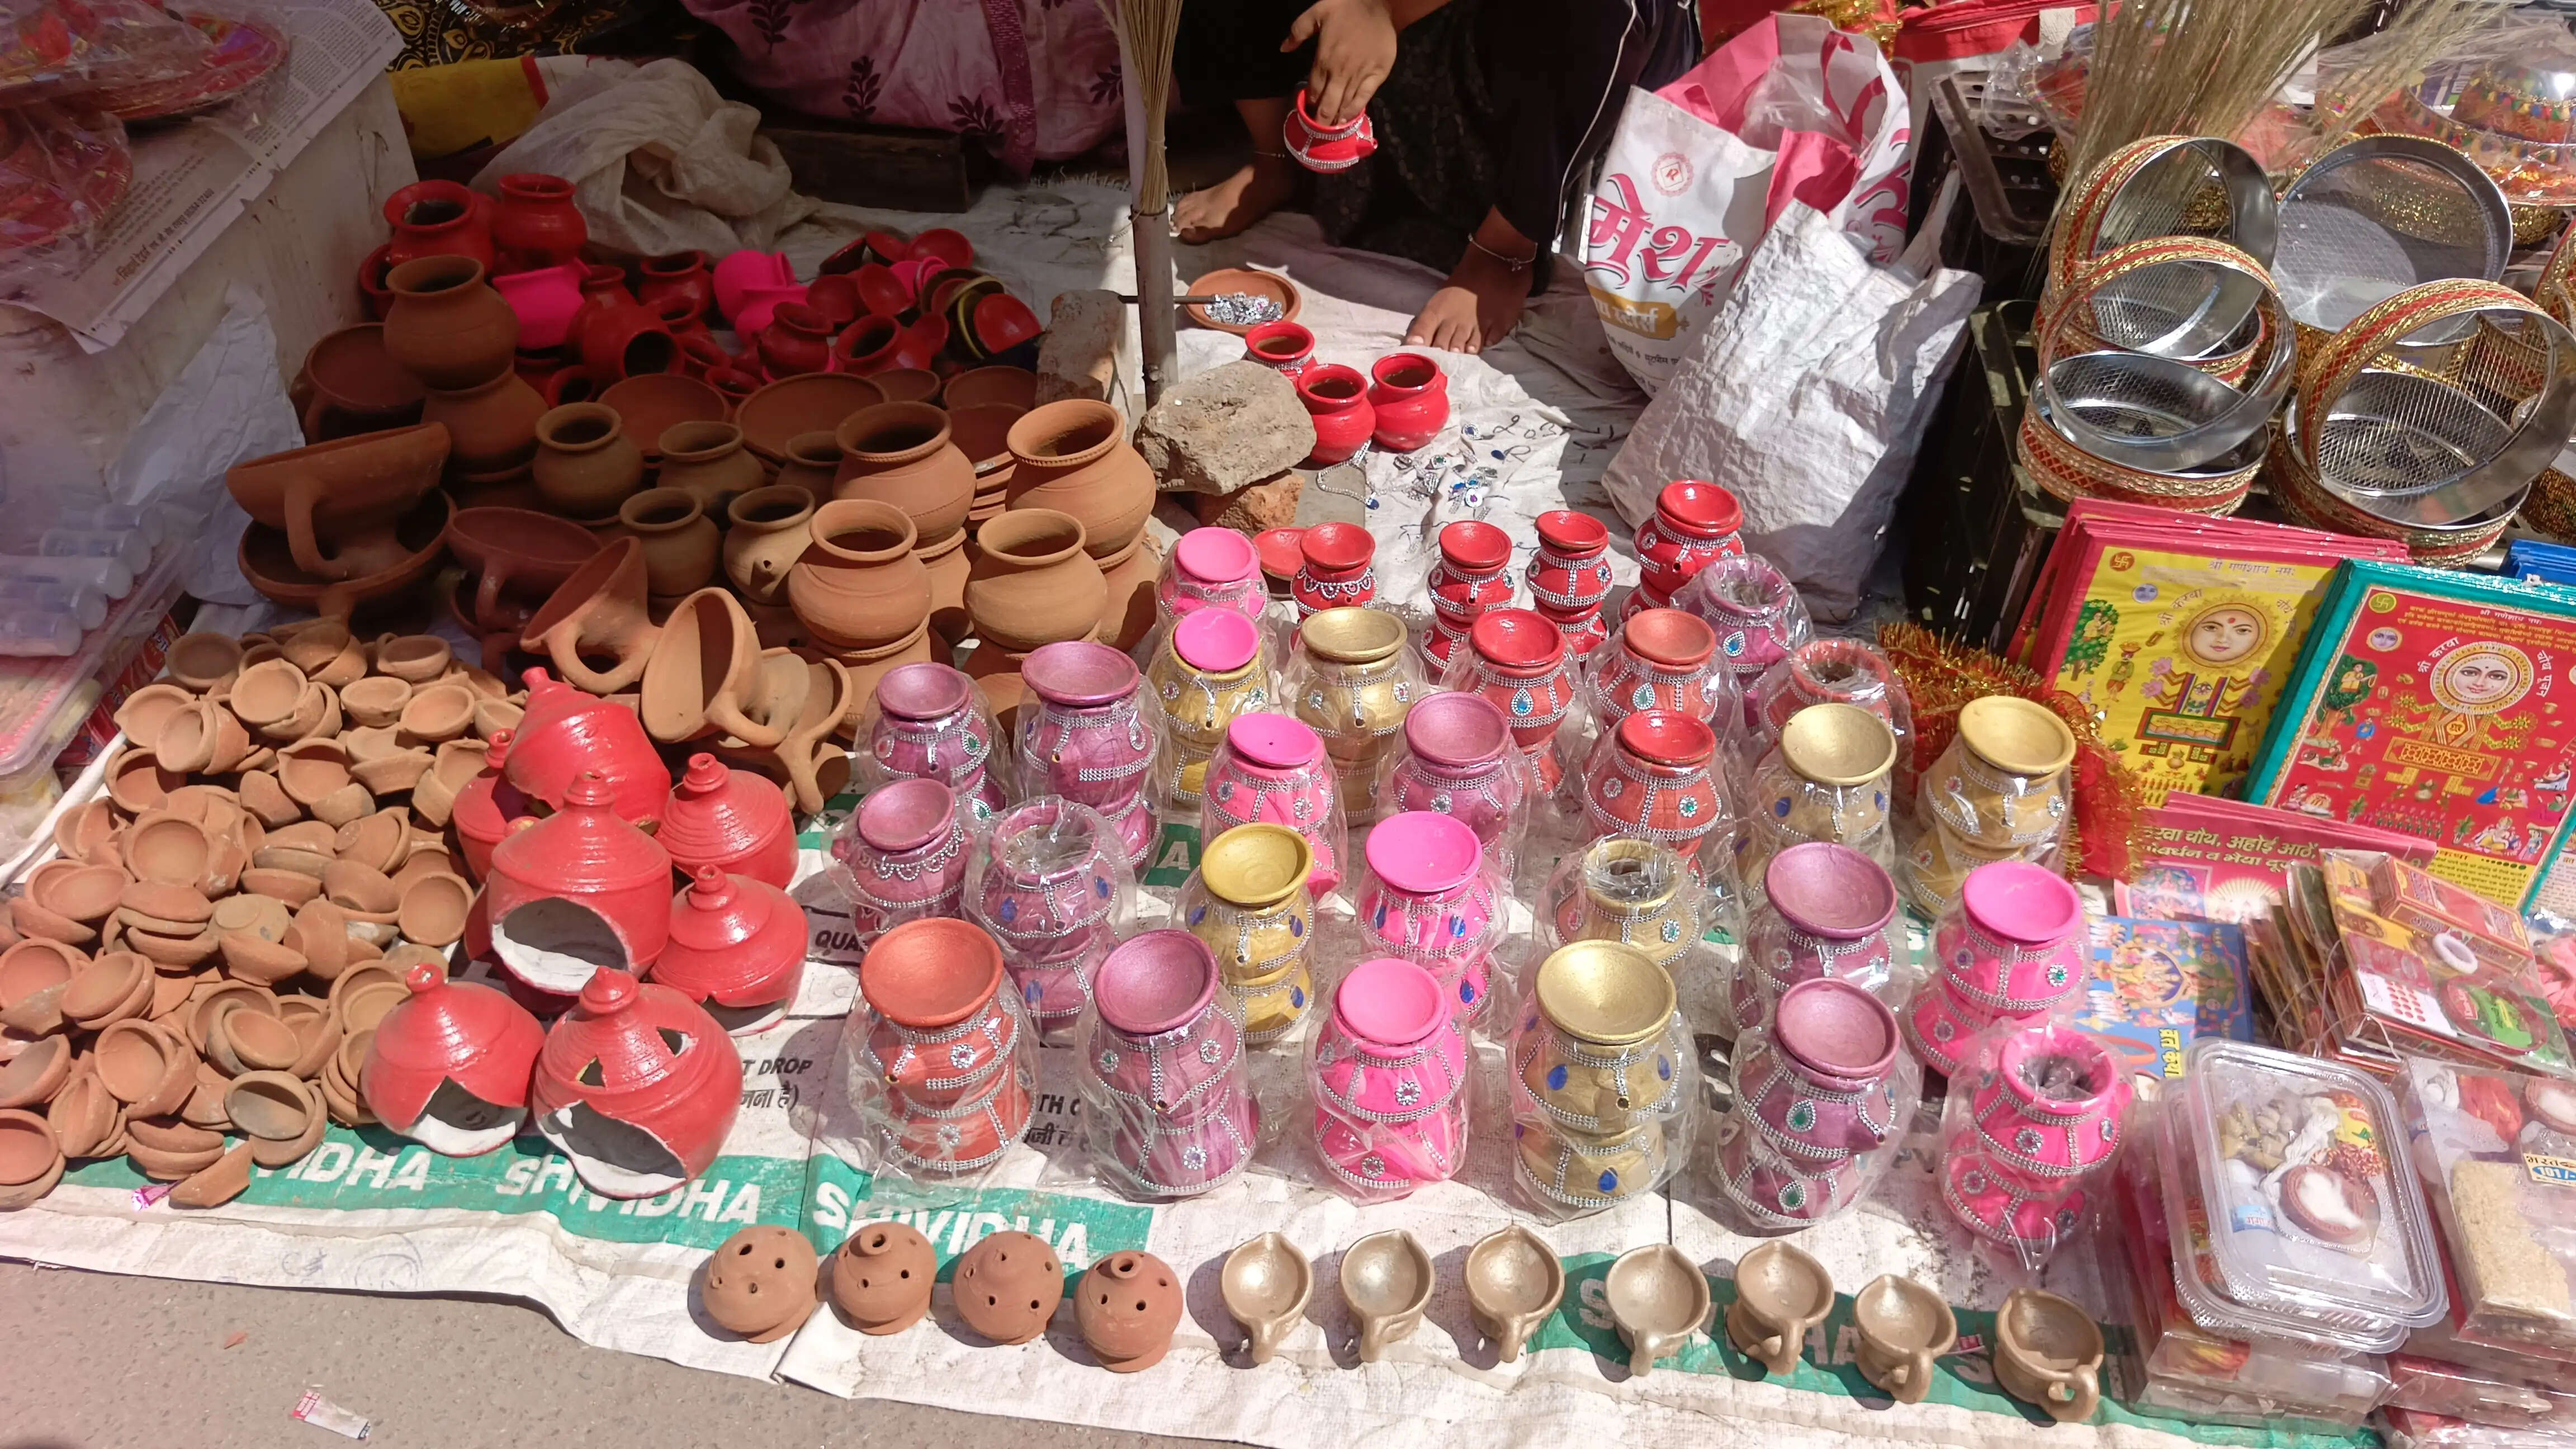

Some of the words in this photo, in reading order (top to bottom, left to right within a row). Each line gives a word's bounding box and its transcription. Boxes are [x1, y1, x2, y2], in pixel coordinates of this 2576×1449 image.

[2428, 636, 2459, 659] करवा
[2186, 827, 2220, 848] चौथ,
[2226, 835, 2279, 855] अहोई
[815, 930, 864, 953] QUA
[758, 1057, 813, 1075] DROP
